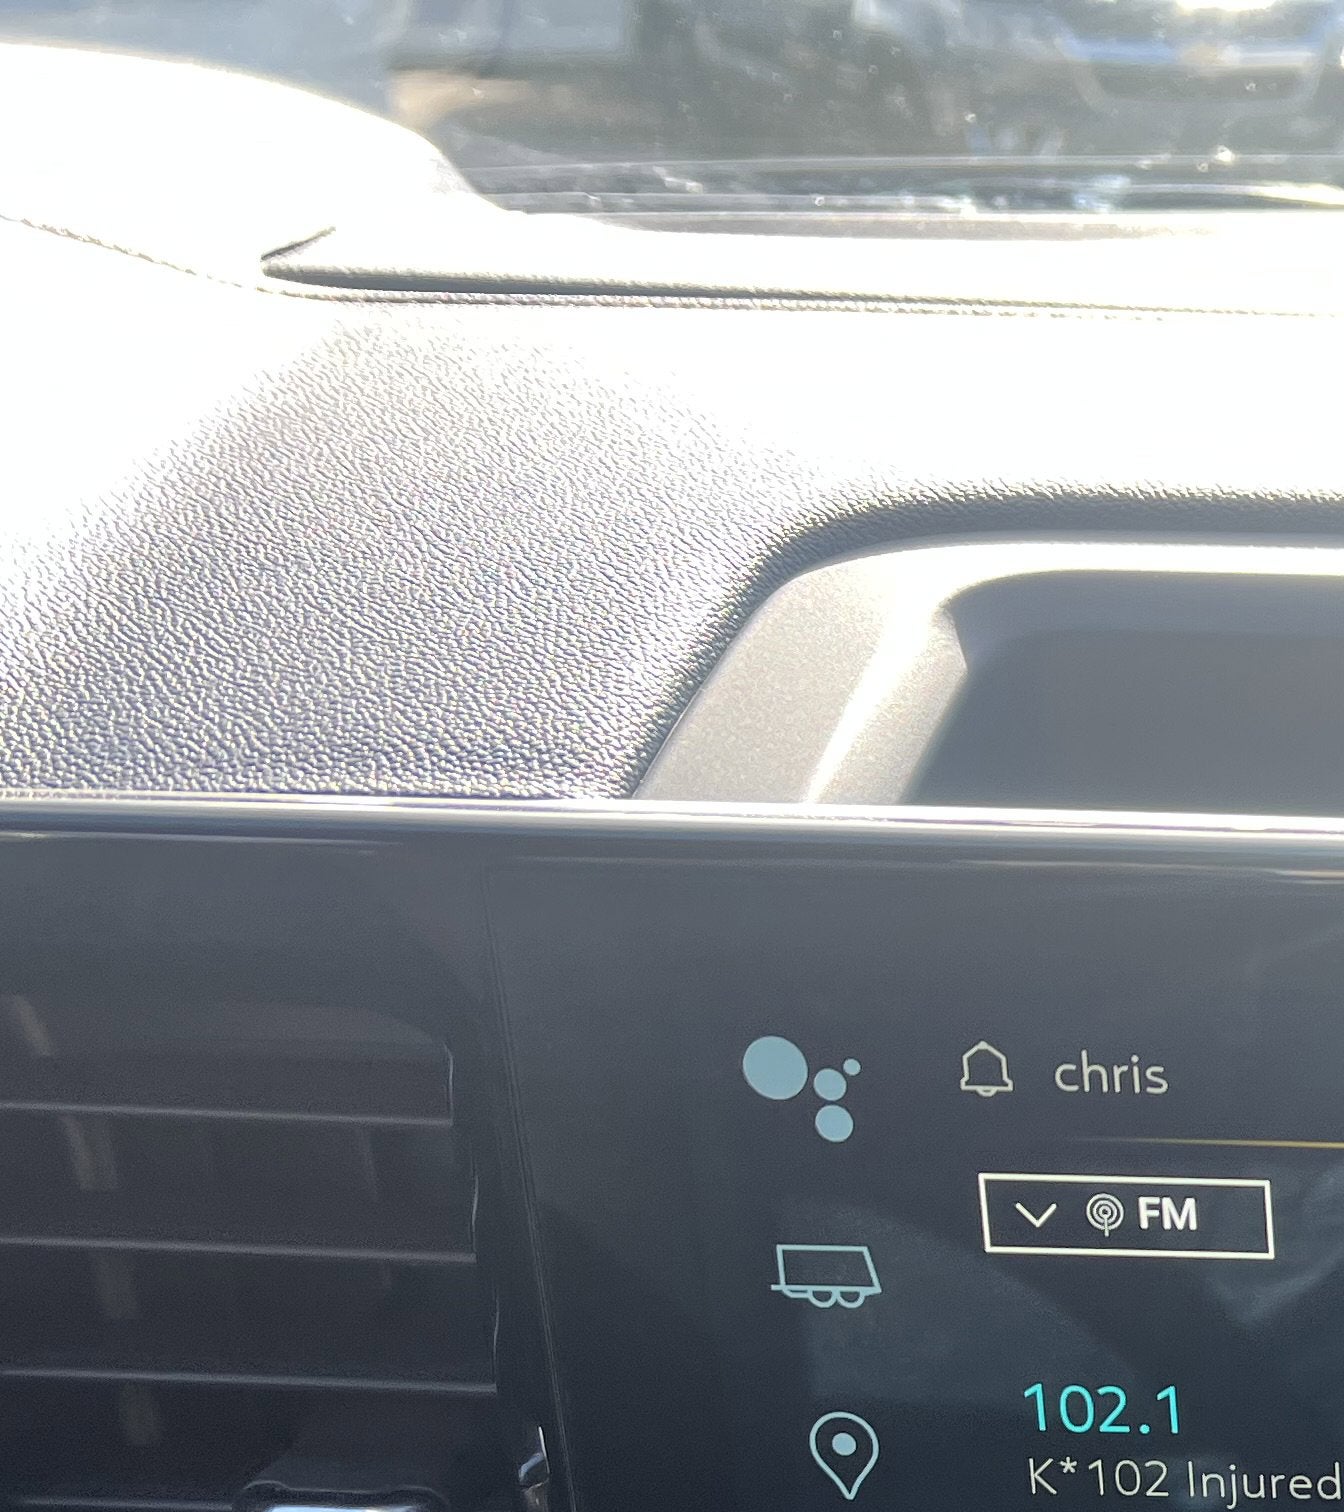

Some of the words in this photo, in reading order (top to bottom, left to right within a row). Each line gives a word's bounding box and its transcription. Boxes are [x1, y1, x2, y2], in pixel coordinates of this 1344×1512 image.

[1054, 1049, 1169, 1094] chris
[1138, 1196, 1198, 1231] FM
[1023, 1383, 1179, 1434] 102.1
